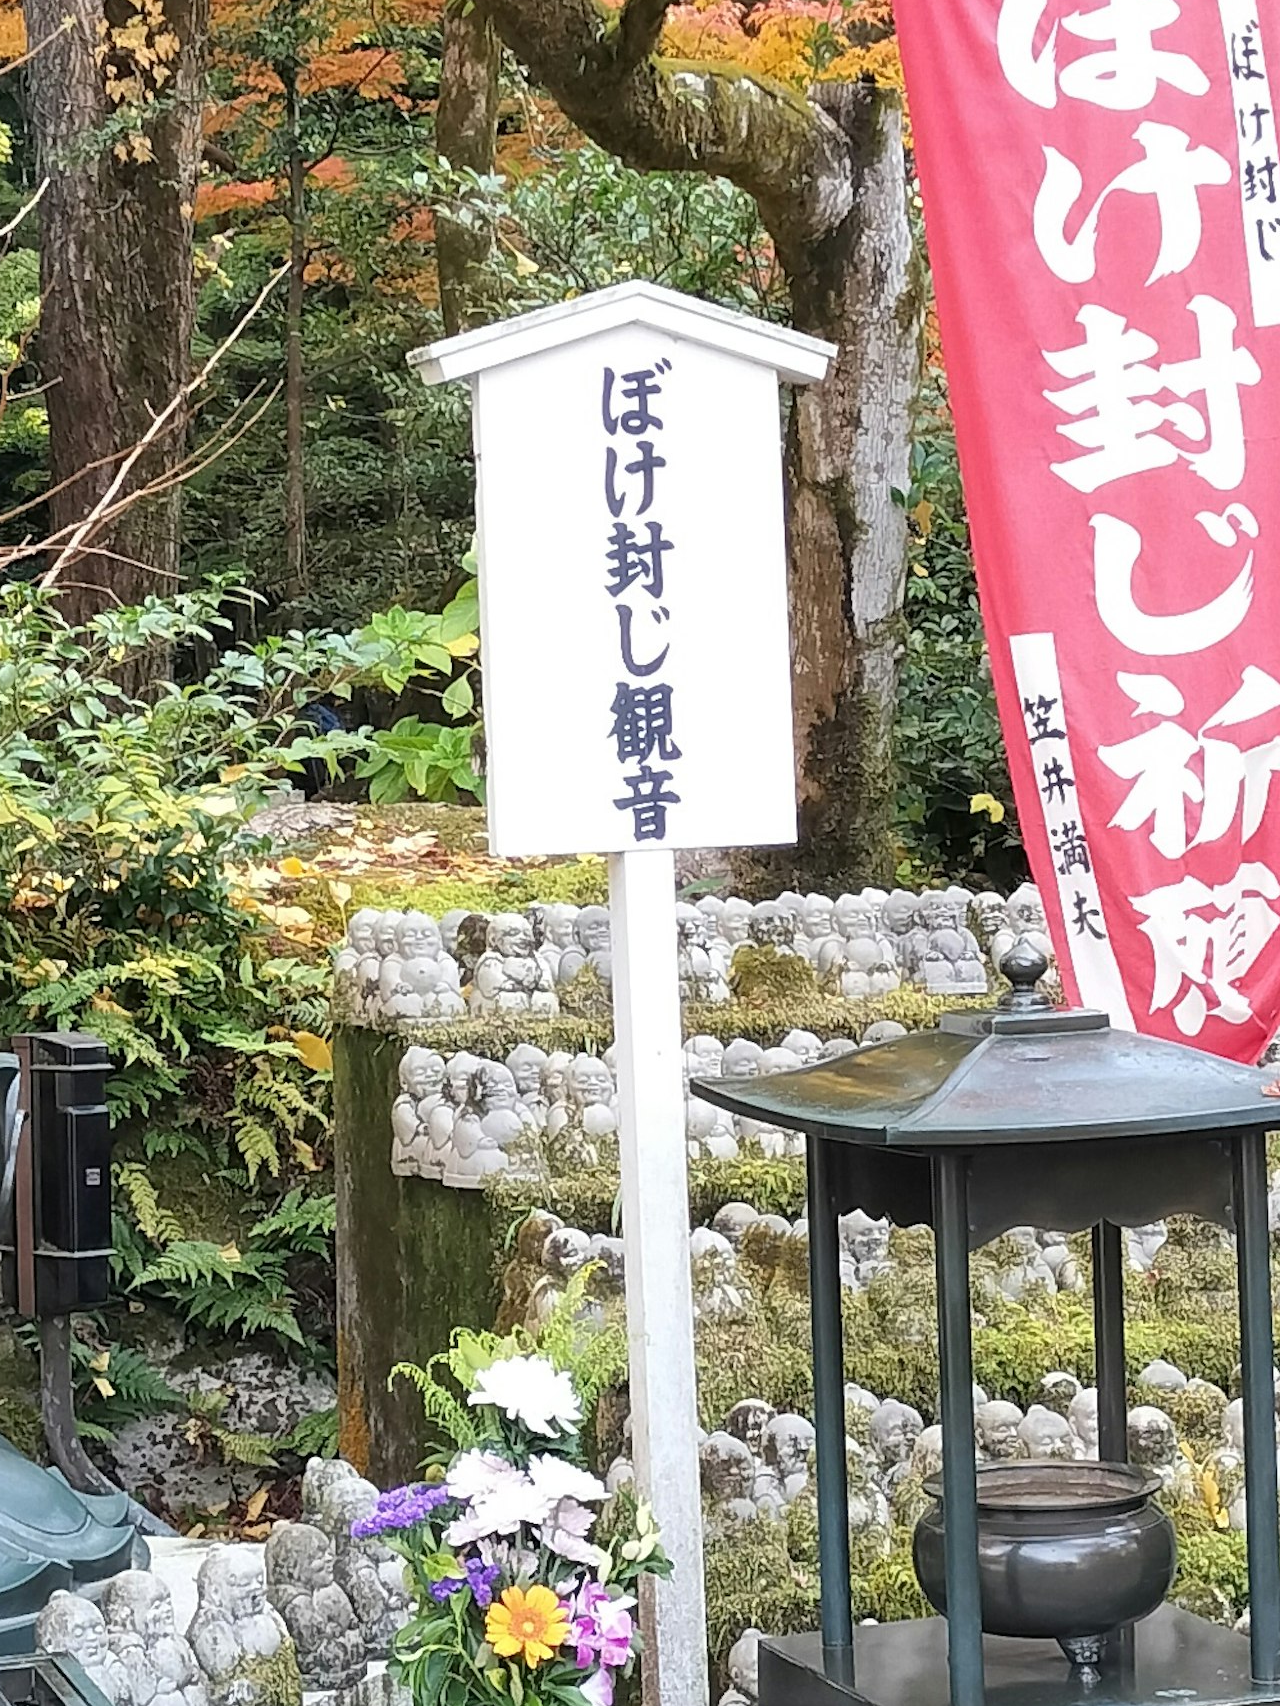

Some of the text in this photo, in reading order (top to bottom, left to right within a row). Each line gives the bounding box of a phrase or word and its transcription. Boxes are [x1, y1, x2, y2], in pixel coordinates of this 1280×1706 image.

[602, 357, 683, 842] ぼけ封じ観音
